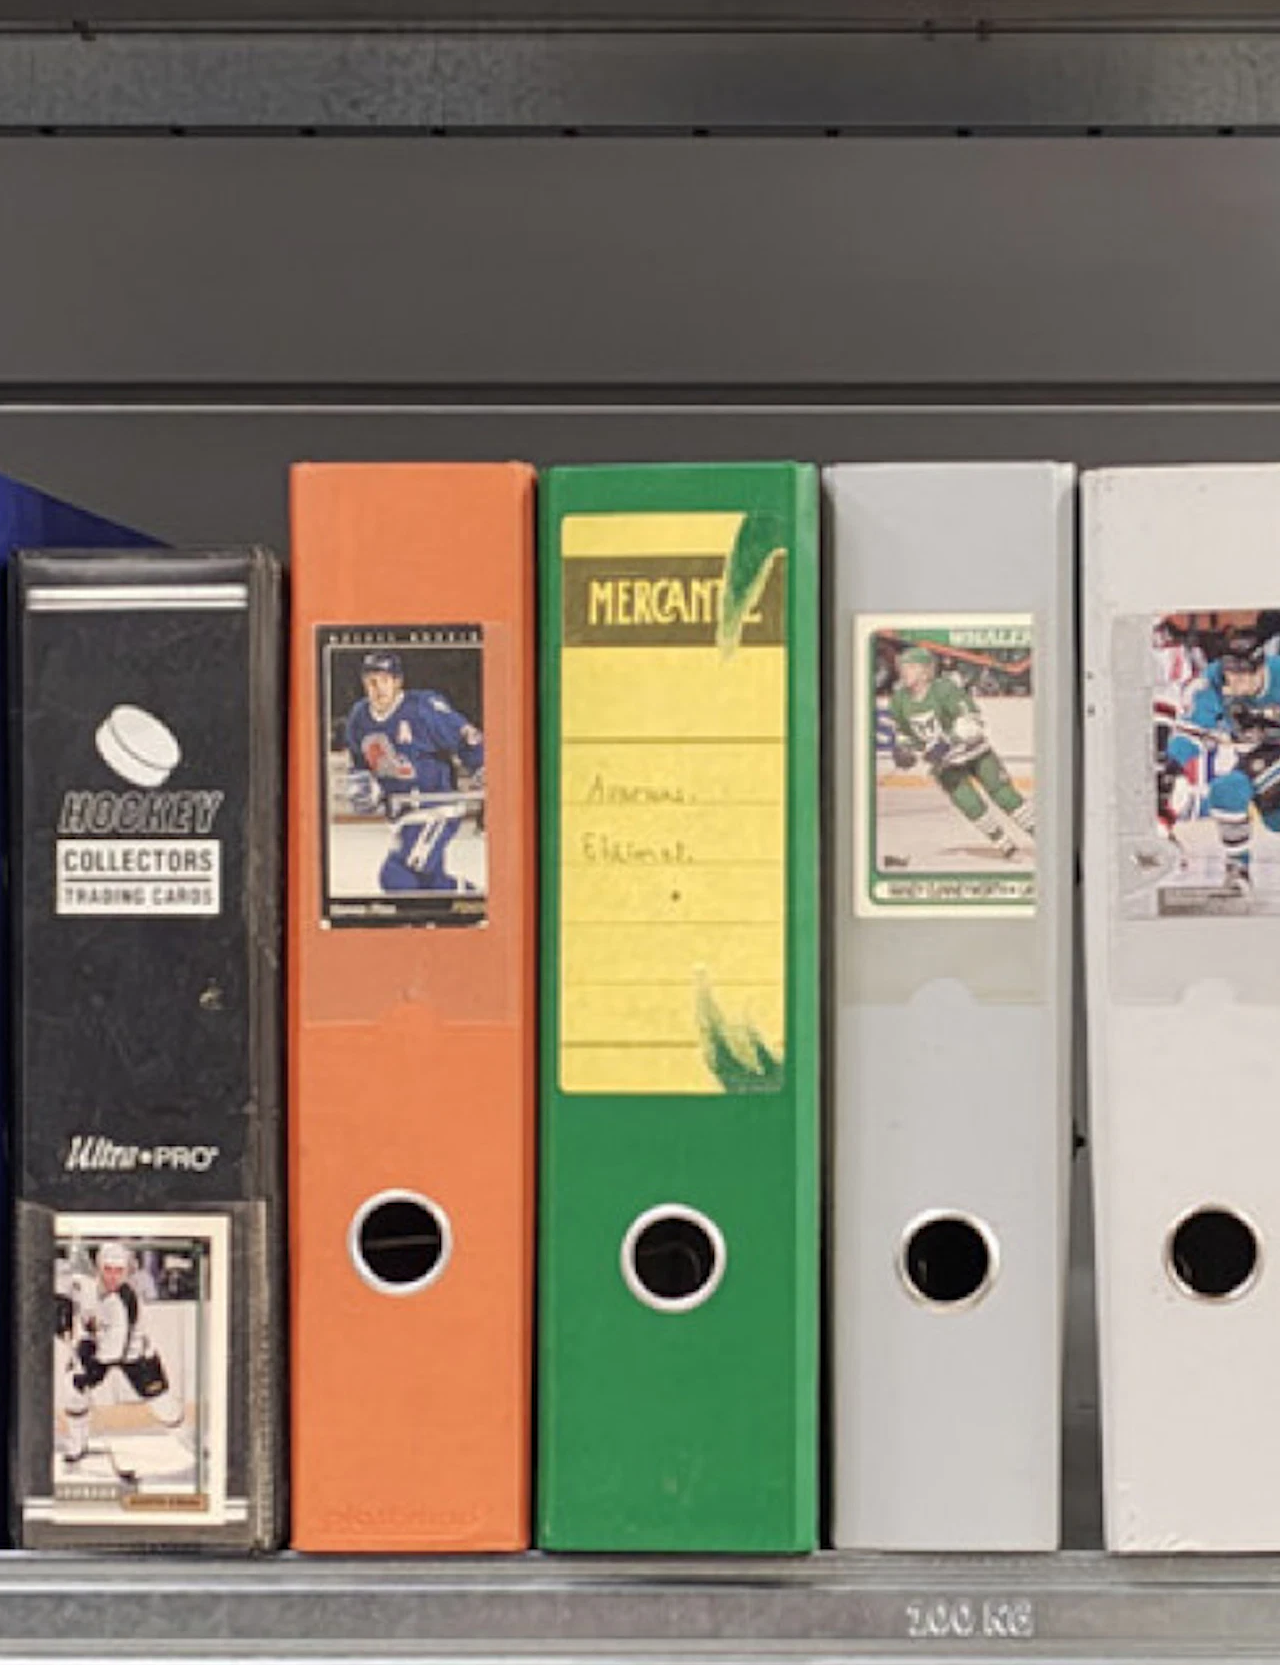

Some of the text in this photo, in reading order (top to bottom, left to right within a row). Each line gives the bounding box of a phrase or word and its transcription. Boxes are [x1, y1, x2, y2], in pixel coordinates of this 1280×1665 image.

[587, 577, 763, 627] MERCANT
[57, 790, 224, 834] HOCKEY
[63, 848, 214, 873] COLLECTORS
[64, 887, 214, 908] TRADING CARDS
[906, 1597, 1035, 1639] 200 KG
